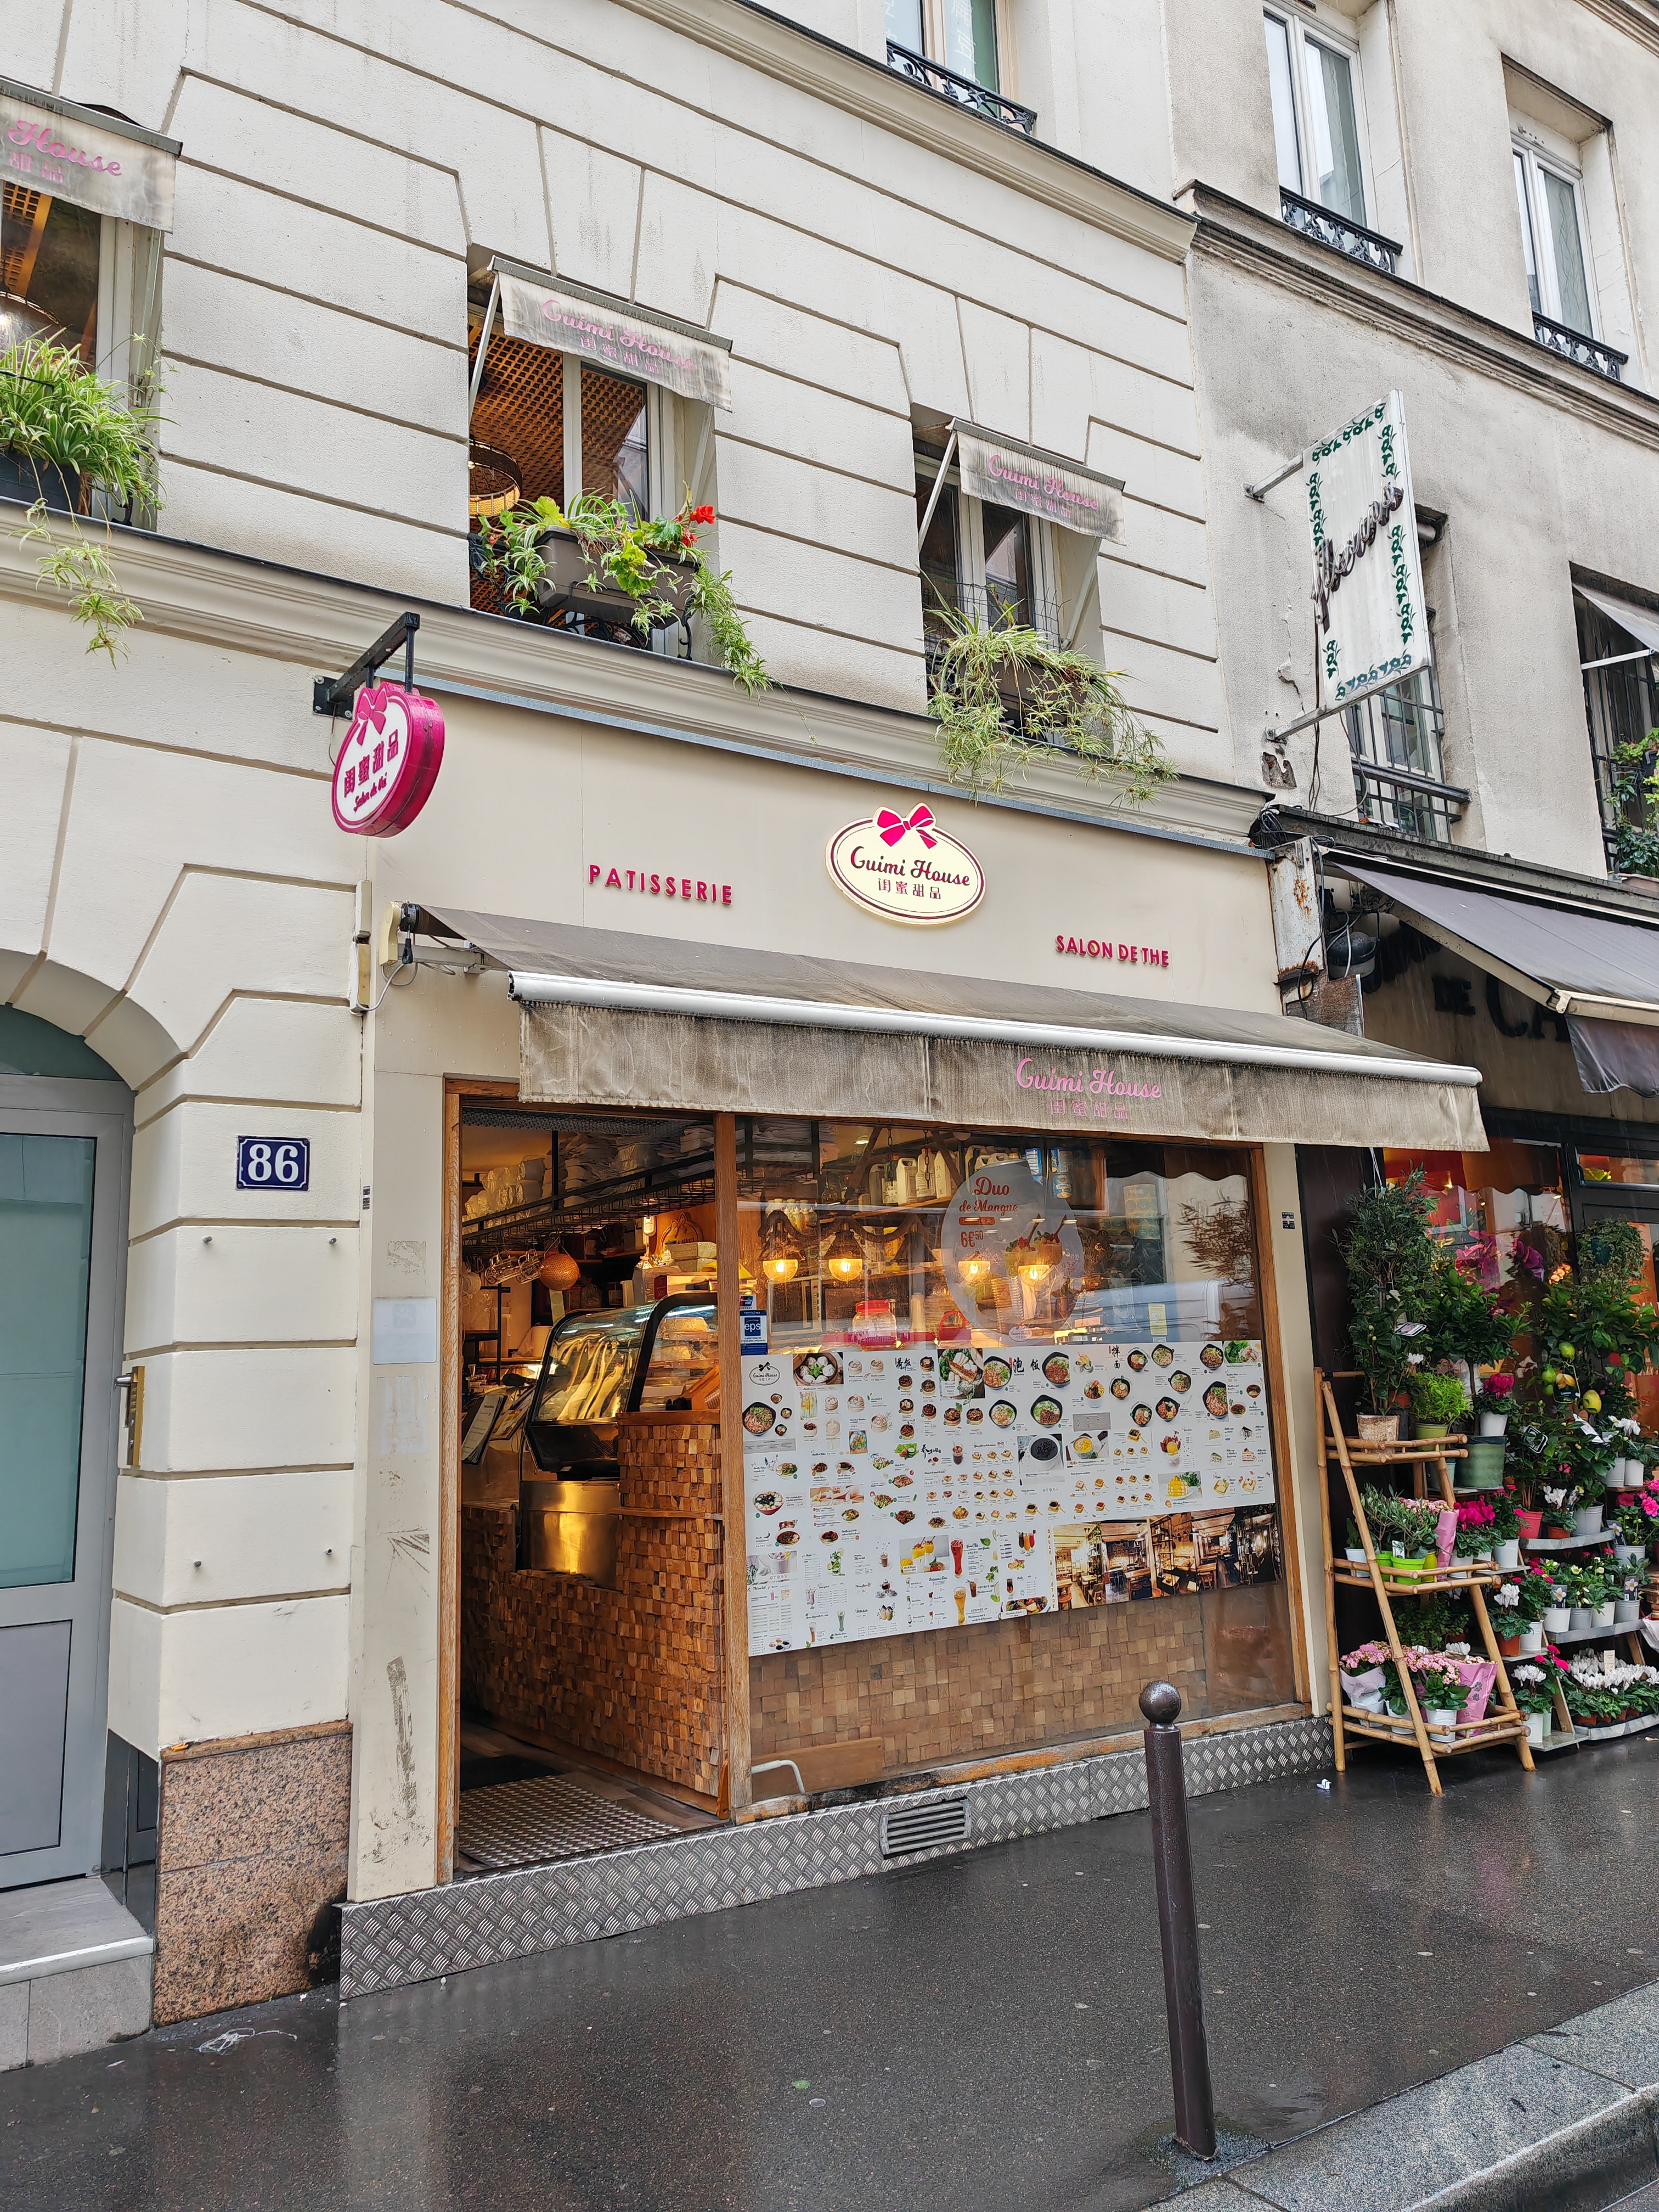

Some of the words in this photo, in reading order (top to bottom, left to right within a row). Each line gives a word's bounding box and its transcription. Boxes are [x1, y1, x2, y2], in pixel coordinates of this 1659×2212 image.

[8, 120, 122, 177] House
[542, 299, 614, 341] Guimi
[620, 328, 696, 370] House
[989, 454, 1040, 490] Guimi
[1043, 476, 1098, 510] House
[589, 864, 732, 905] PATISSERIE
[850, 845, 906, 876] Guimi
[910, 859, 970, 886] House
[878, 878, 941, 900] 闺蜜甜品
[1056, 935, 1113, 960] SALON
[1118, 944, 1138, 963] DE
[1142, 947, 1169, 967] THE
[1016, 1057, 1084, 1093] Guimi
[1088, 1069, 1161, 1099] House
[1049, 1097, 1128, 1120] 闺蜜甜品
[247, 1144, 299, 1182] 86
[974, 1176, 1010, 1195] Duo
[959, 1199, 972, 1212] de
[973, 1199, 1018, 1216] Mangue
[744, 1323, 761, 1333] eps
